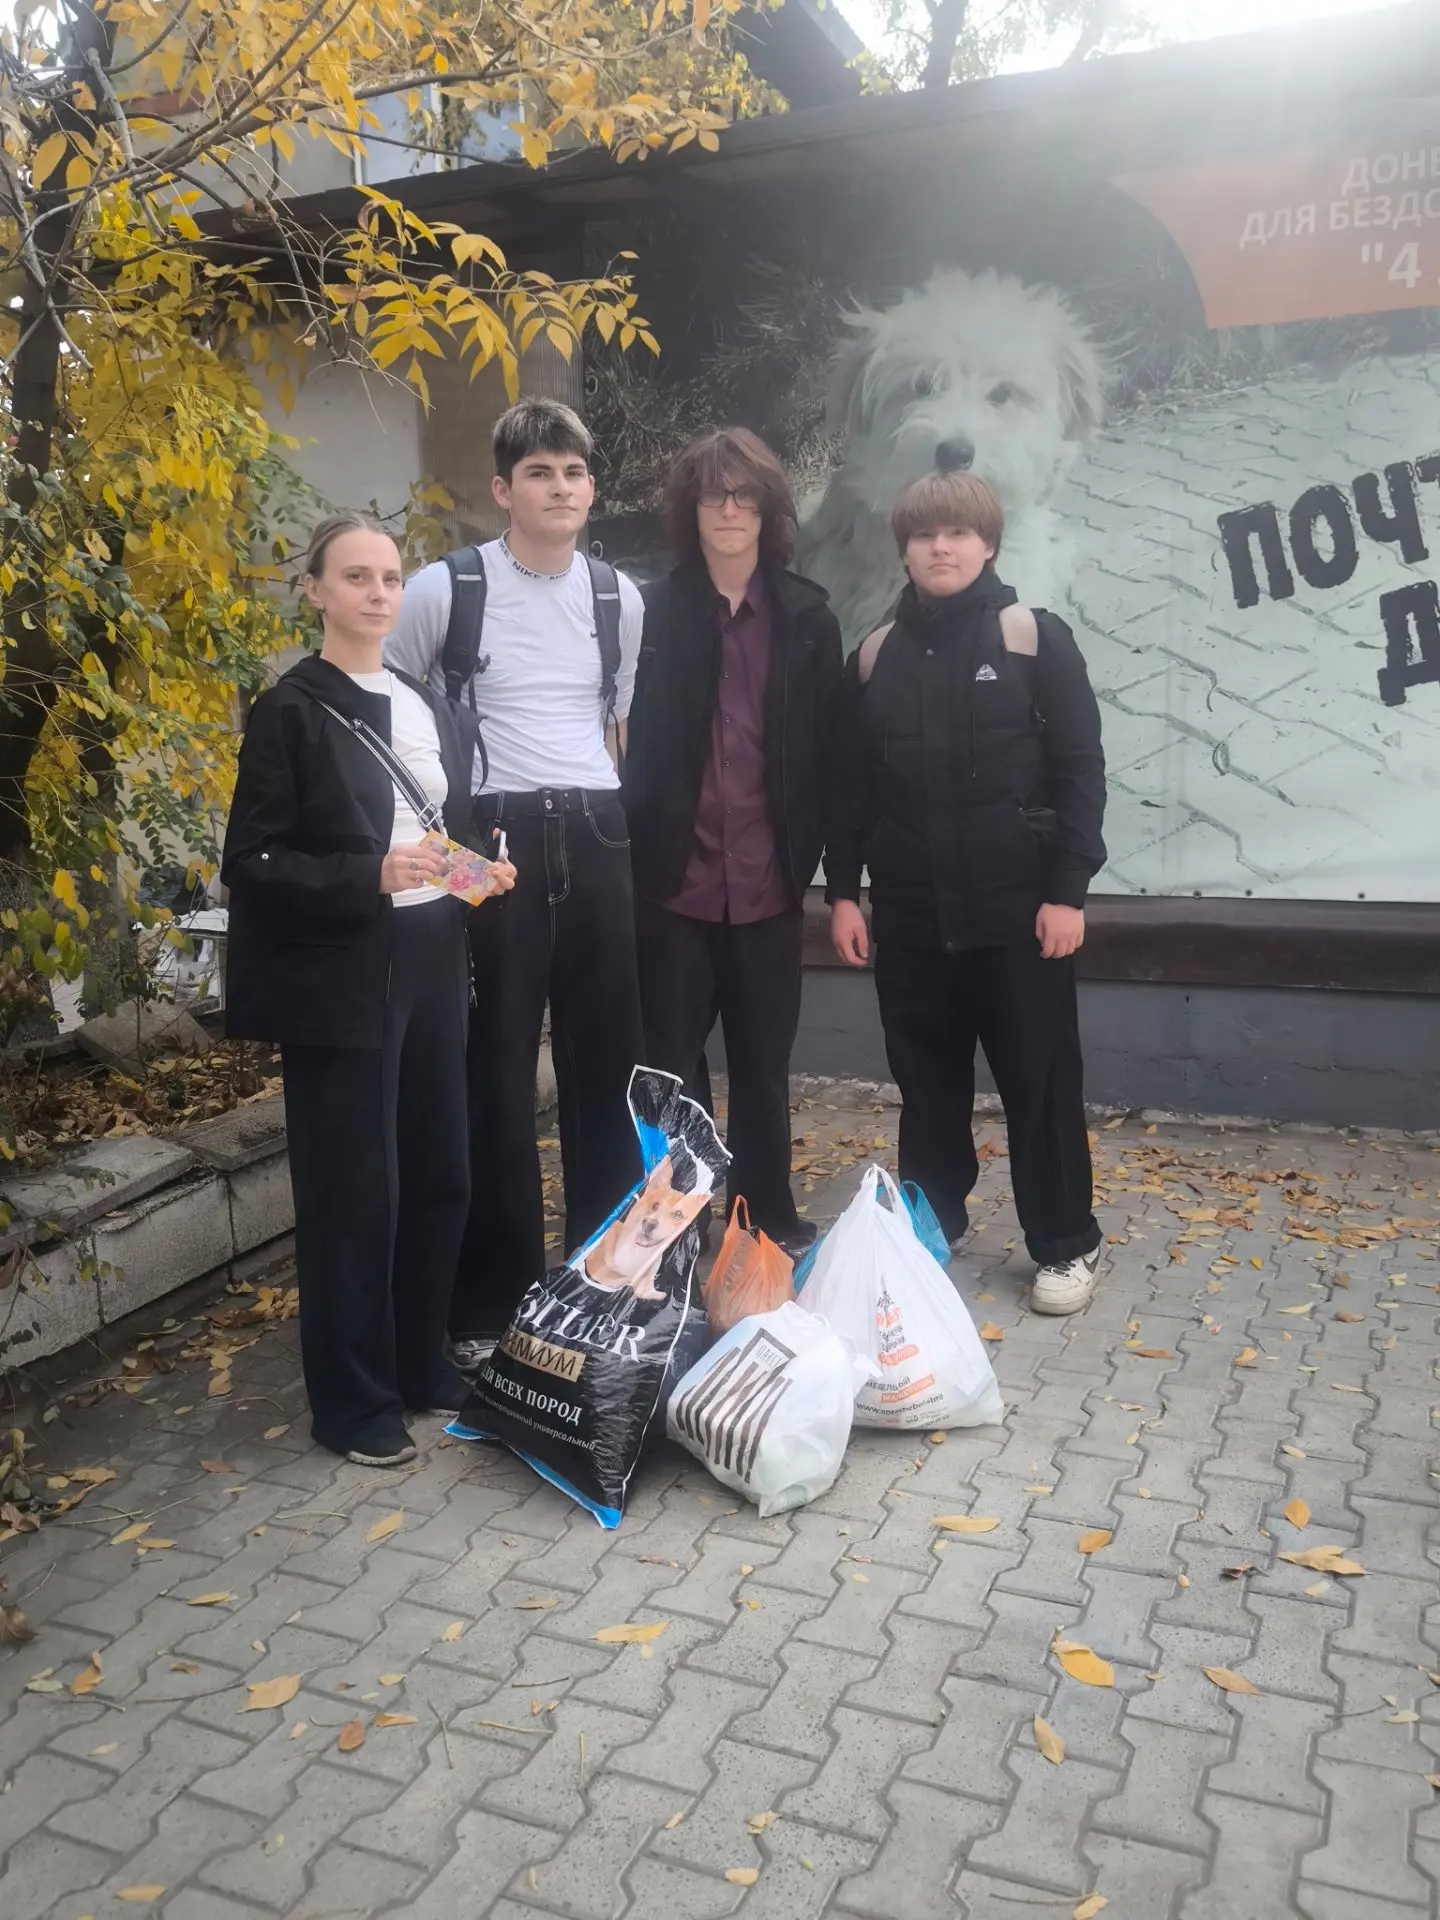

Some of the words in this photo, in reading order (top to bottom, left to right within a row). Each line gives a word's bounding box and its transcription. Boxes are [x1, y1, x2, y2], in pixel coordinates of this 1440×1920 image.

[1239, 203, 1317, 250] ДЛЯ
[494, 1373, 524, 1401] ВСЕХ
[526, 1389, 582, 1426] ПОРОД
[533, 1420, 597, 1451] универсальный
